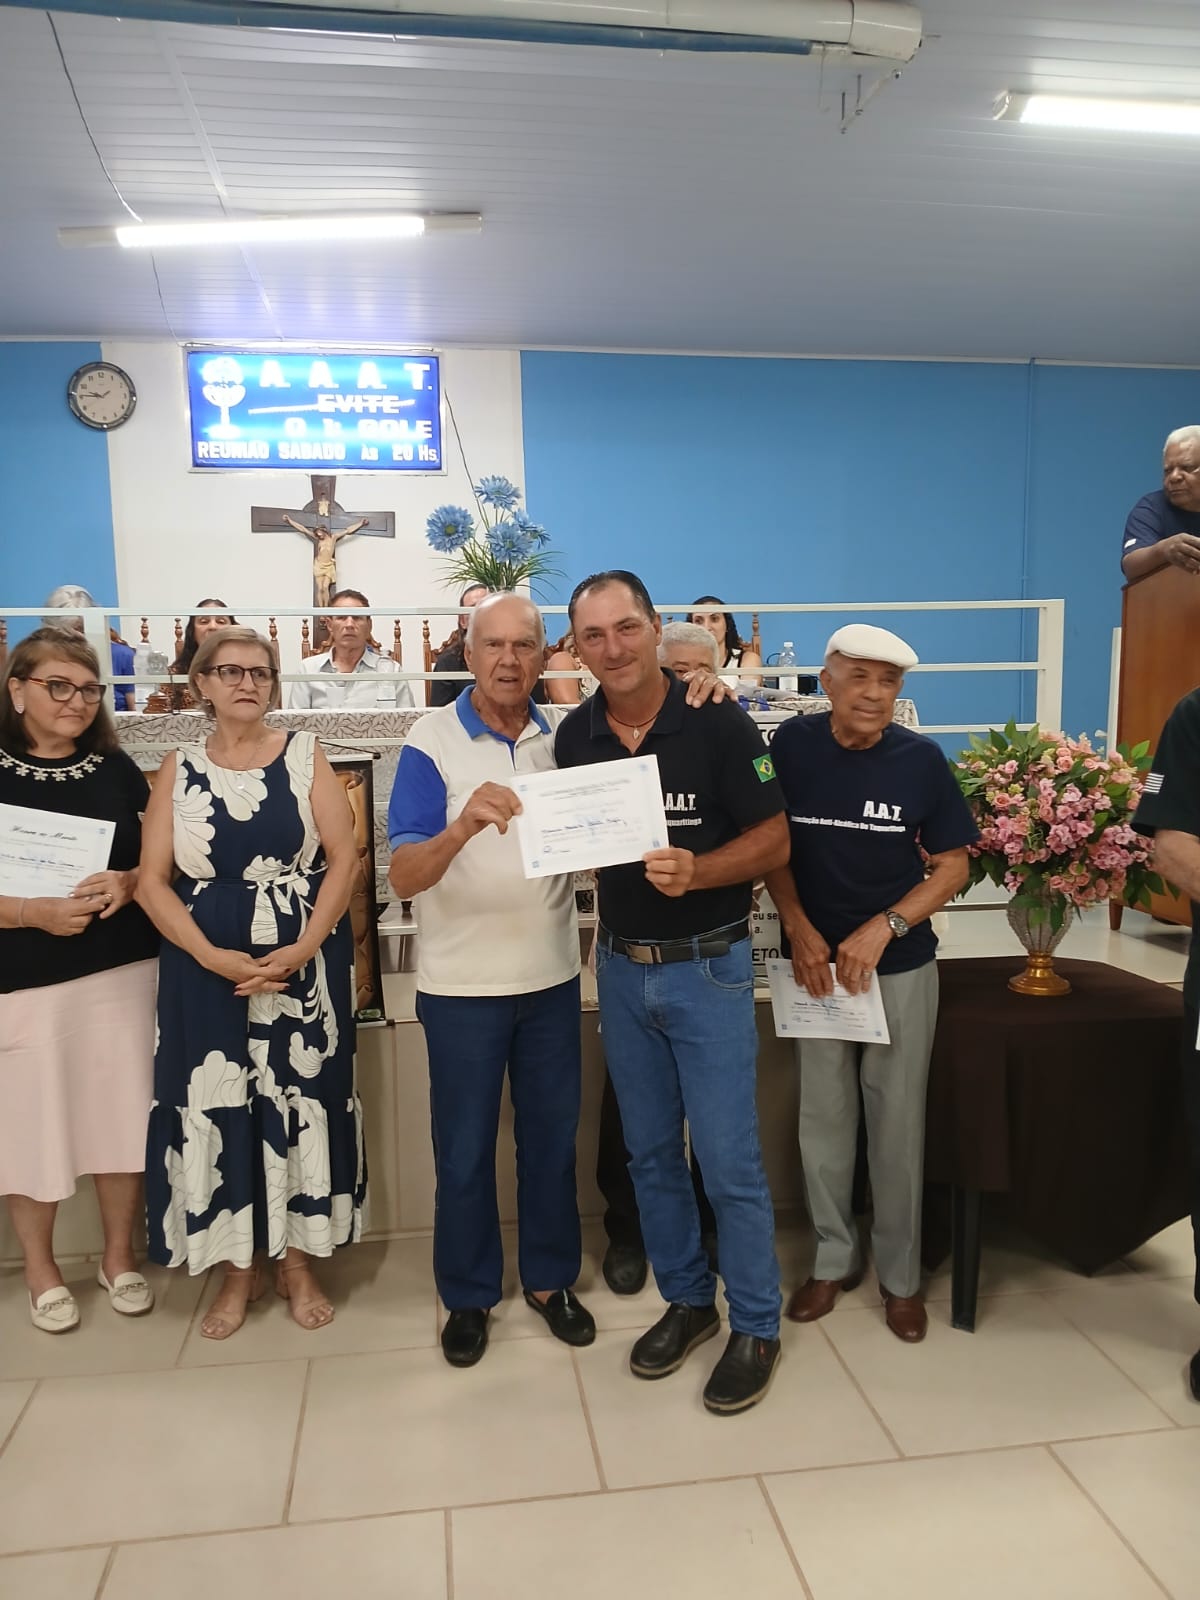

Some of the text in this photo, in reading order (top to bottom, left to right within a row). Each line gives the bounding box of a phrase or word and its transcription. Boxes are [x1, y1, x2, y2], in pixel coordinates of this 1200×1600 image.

[404, 363, 432, 390] T.
[317, 394, 400, 414] EVITE
[357, 419, 432, 439] GOLE
